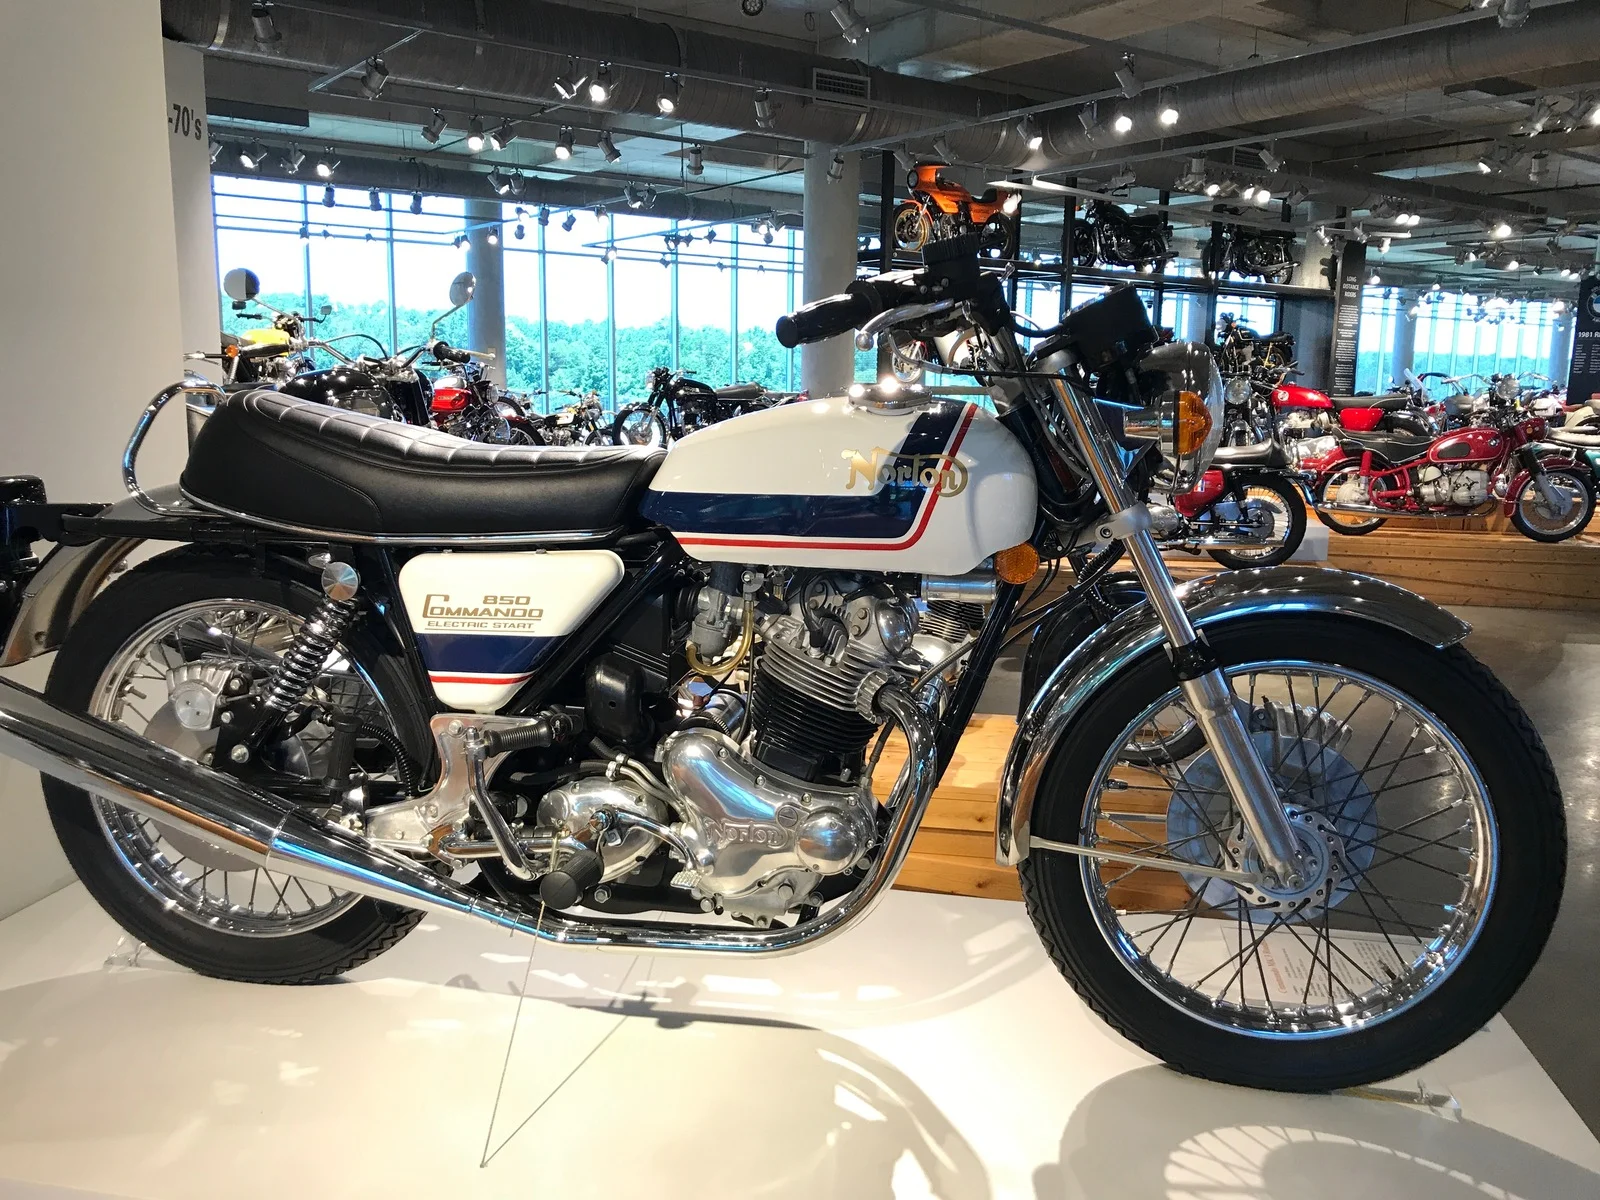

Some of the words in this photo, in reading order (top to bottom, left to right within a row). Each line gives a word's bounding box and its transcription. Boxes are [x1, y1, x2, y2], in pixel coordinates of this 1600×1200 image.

[841, 446, 968, 497] Norton
[422, 594, 544, 620] COMMANDO
[482, 595, 531, 606] 850
[427, 620, 489, 629] ELECTRIC
[493, 622, 534, 630] START
[703, 818, 788, 849] Norton
